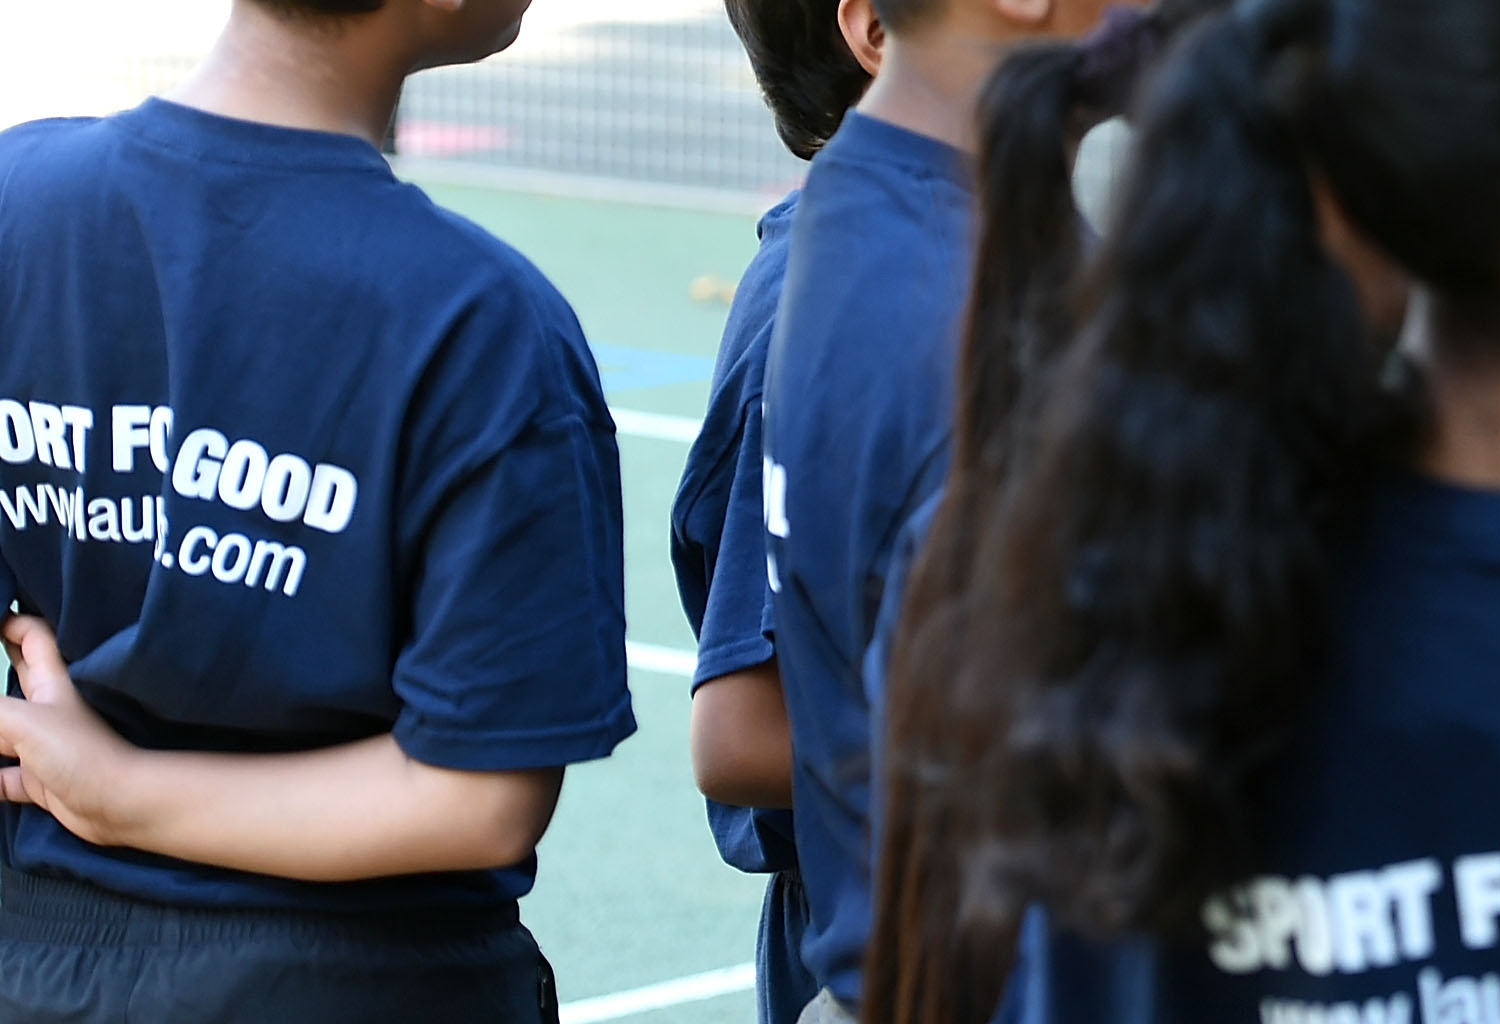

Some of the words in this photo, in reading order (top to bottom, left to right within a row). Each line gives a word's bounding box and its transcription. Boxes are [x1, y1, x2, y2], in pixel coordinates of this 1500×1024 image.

[0, 399, 94, 474] ORT
[112, 405, 174, 474] FO
[172, 428, 358, 533] GOOD
[1201, 857, 1442, 976] SPORT
